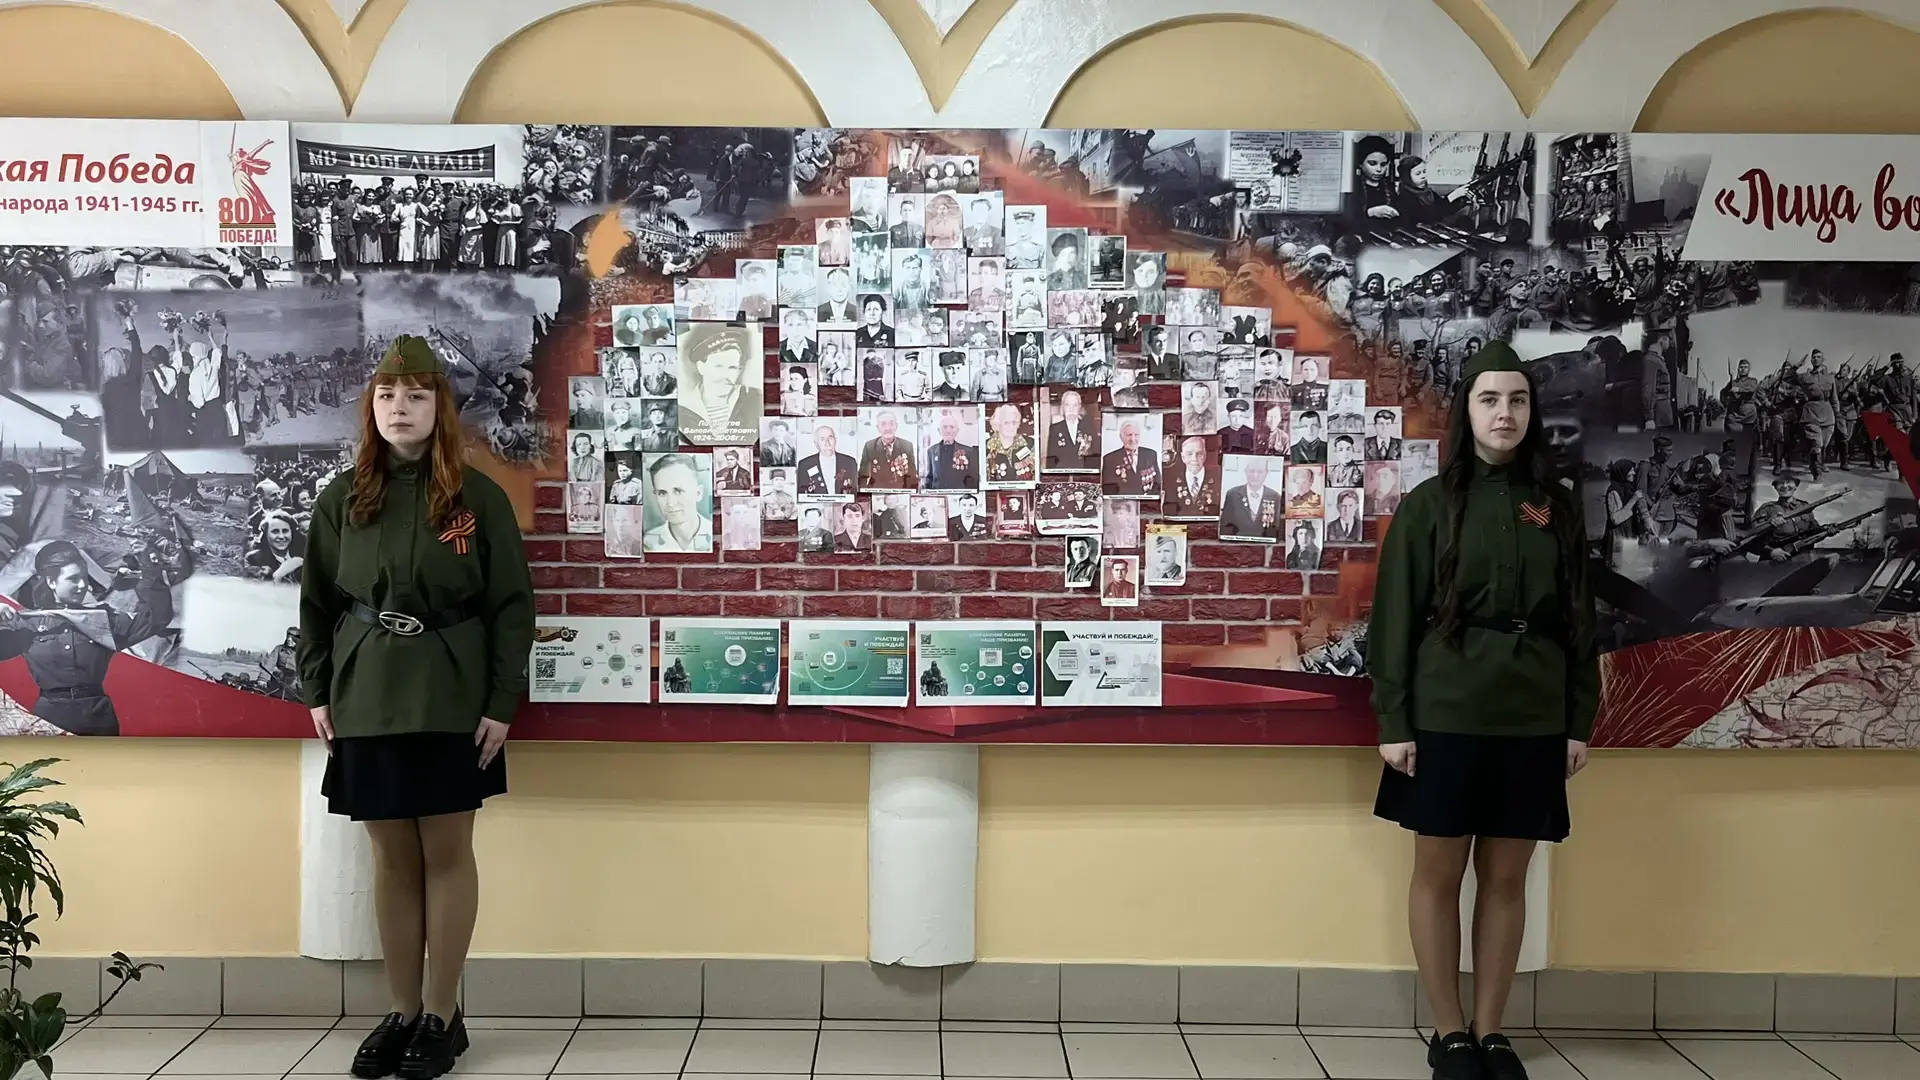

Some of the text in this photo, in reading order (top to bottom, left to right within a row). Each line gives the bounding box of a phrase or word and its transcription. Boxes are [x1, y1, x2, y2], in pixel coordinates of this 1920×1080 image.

[58, 153, 195, 184] Победа
[75, 196, 177, 212] 1941-1945
[182, 200, 204, 213] гг.
[218, 197, 250, 224] 80
[1714, 168, 1862, 243] «Лица
[219, 229, 277, 243] ПОБЕДА!
